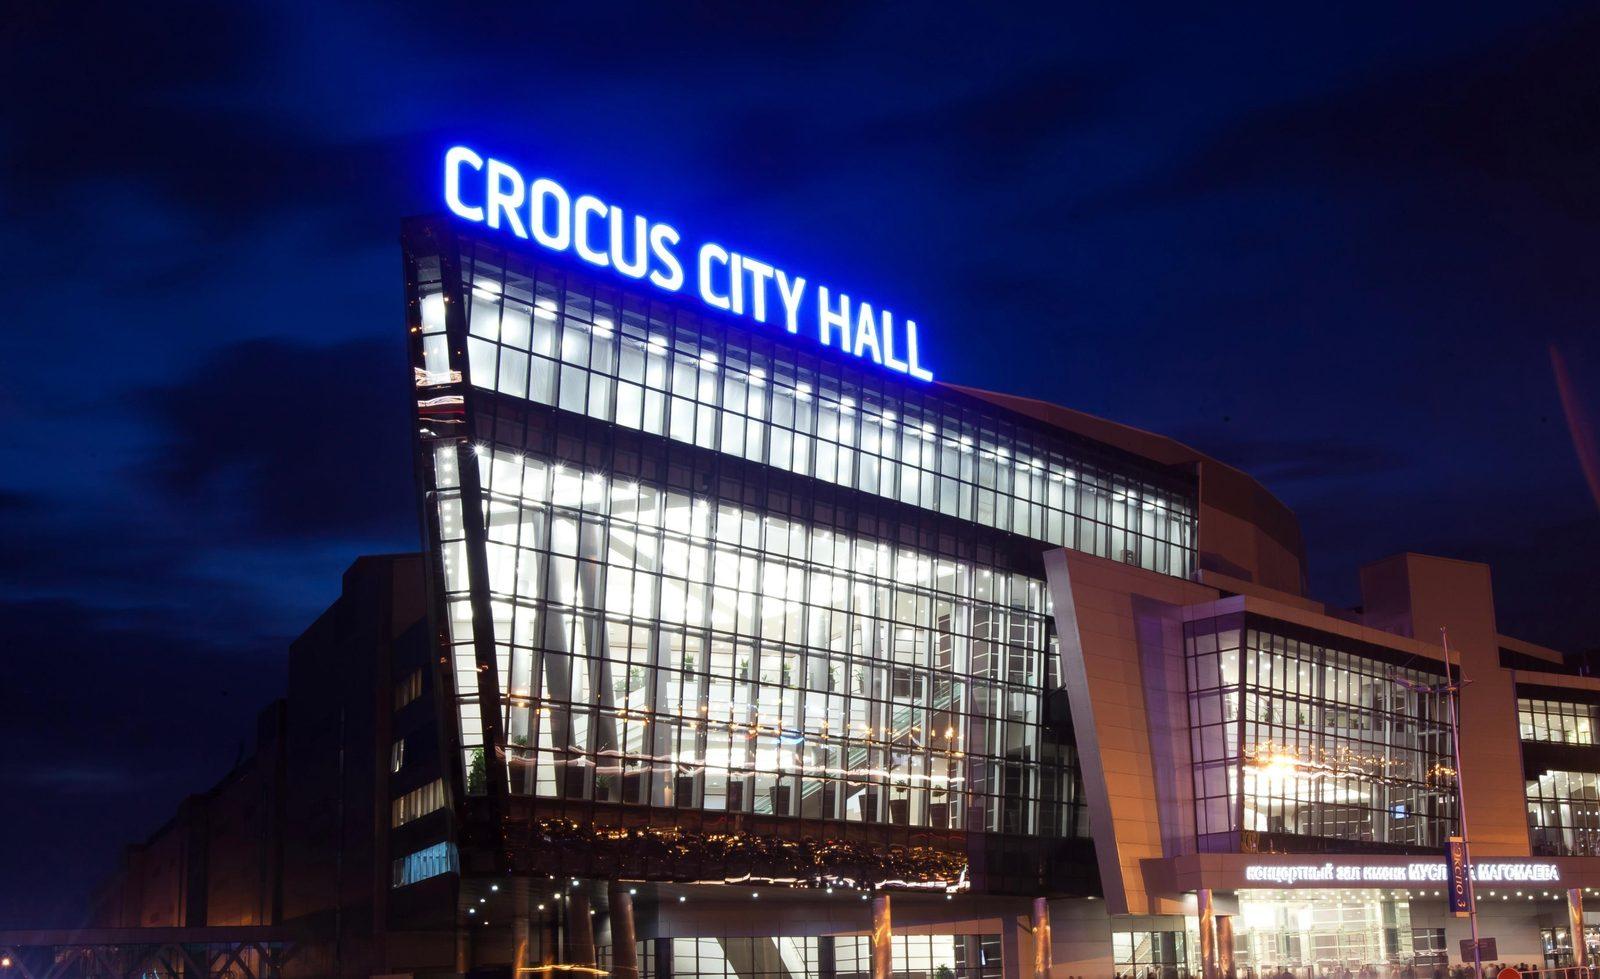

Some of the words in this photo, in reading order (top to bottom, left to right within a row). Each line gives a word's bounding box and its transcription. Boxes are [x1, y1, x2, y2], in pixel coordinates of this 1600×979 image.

[444, 145, 684, 292] CROCUS
[698, 242, 806, 334] CITY
[818, 285, 934, 382] HALL
